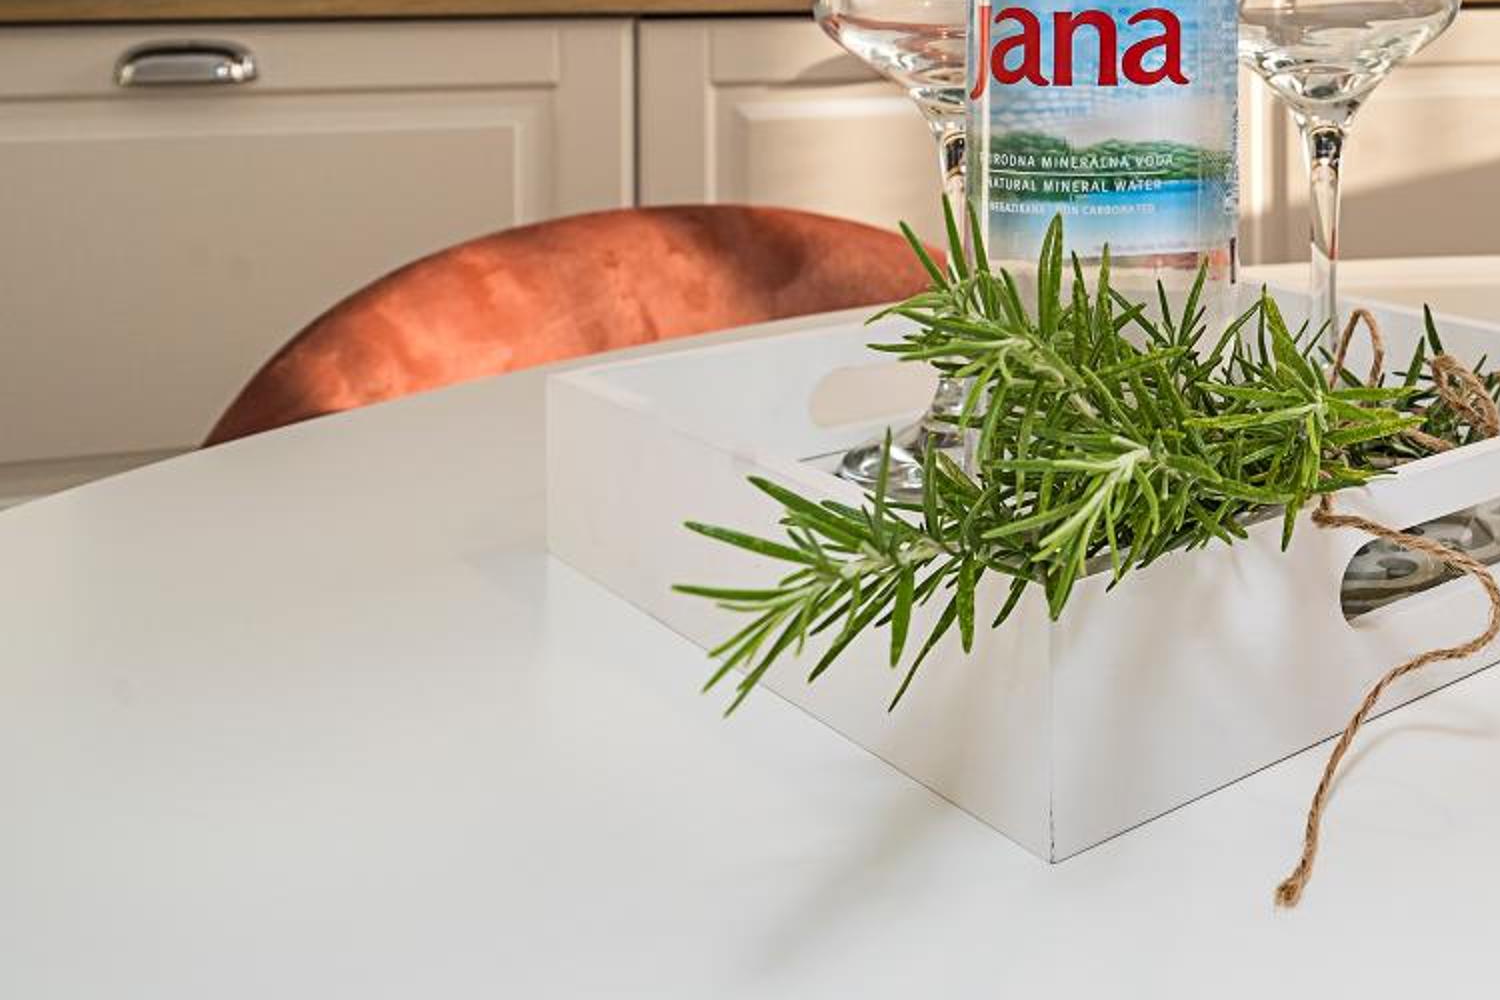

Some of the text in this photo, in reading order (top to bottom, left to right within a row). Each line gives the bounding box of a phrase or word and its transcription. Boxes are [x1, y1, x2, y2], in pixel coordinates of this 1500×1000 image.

[1041, 155, 1130, 170] MINERALNA
[1135, 153, 1174, 168] VODA
[1043, 179, 1109, 193] MINERAL
[1114, 179, 1162, 193] WATER
